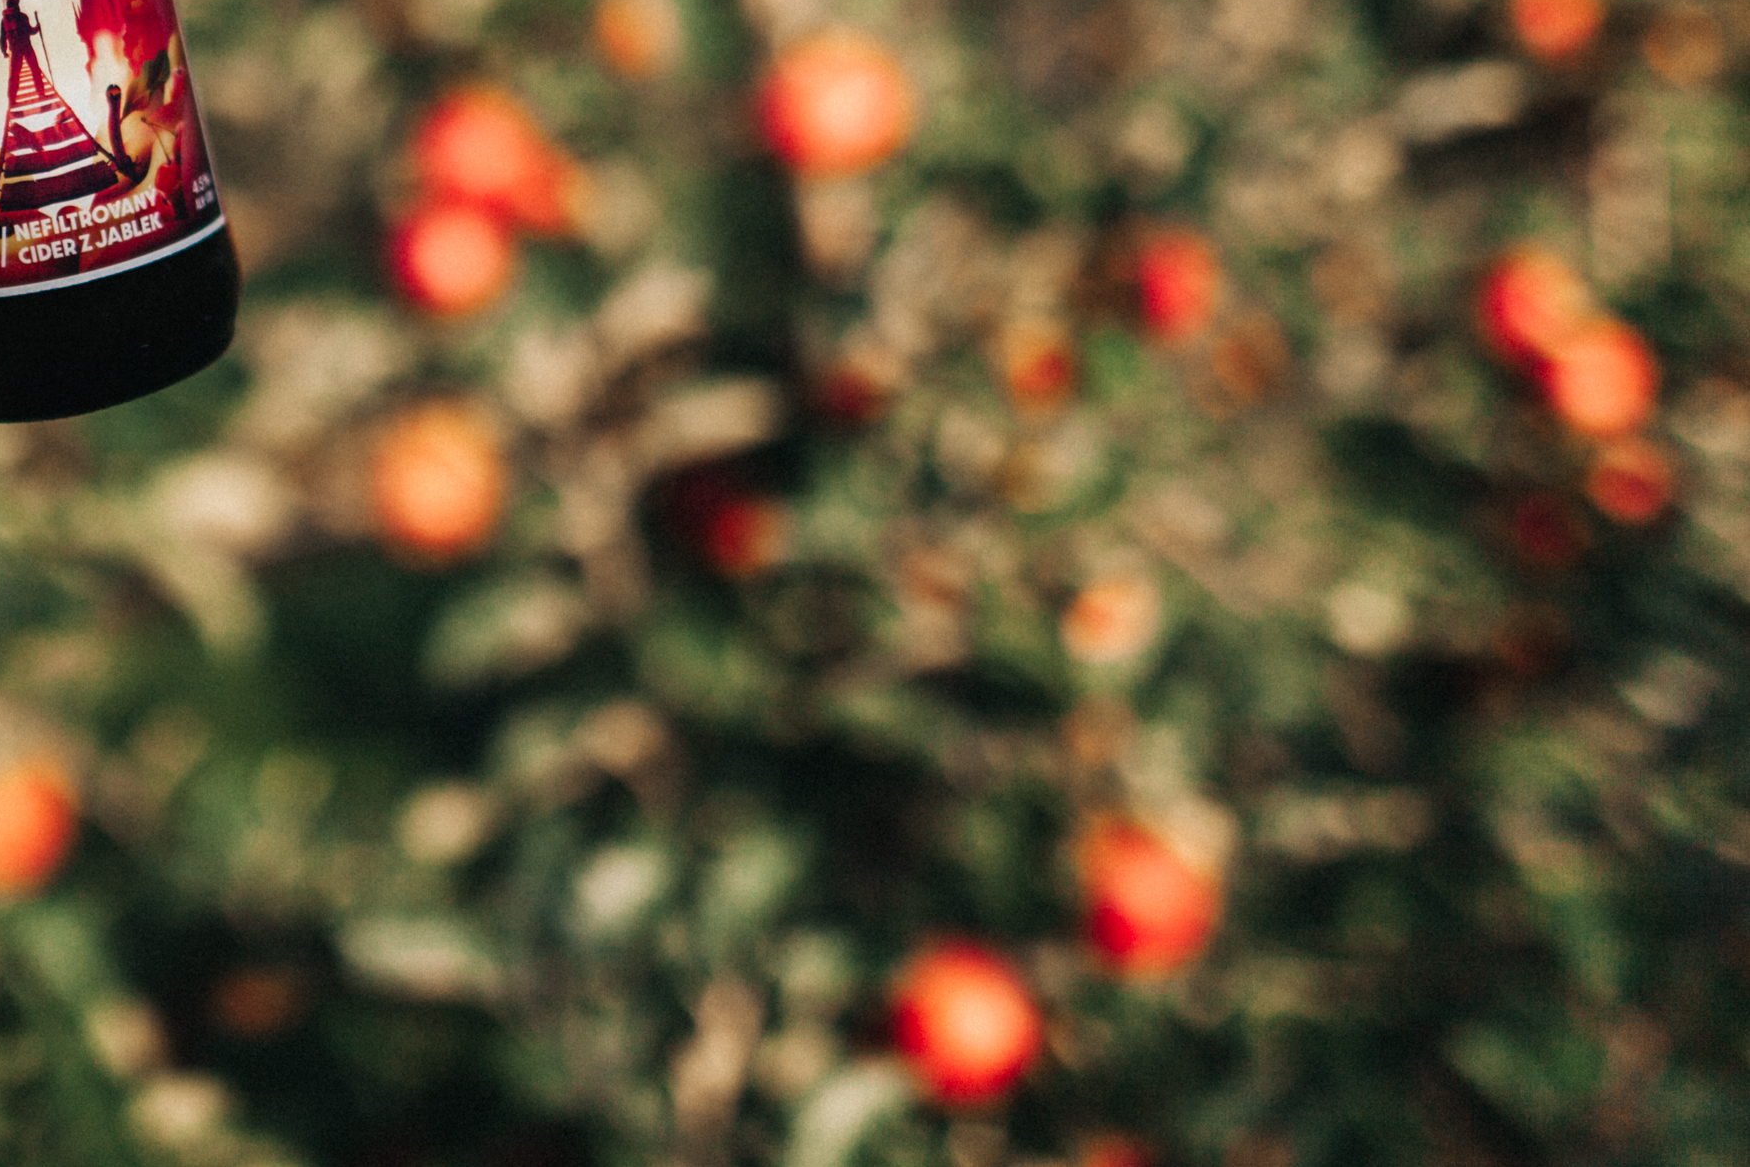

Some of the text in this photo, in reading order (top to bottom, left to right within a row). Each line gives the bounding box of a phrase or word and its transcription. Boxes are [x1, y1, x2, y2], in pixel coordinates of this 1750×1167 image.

[18, 211, 163, 264] CIDER Z JABLEK
